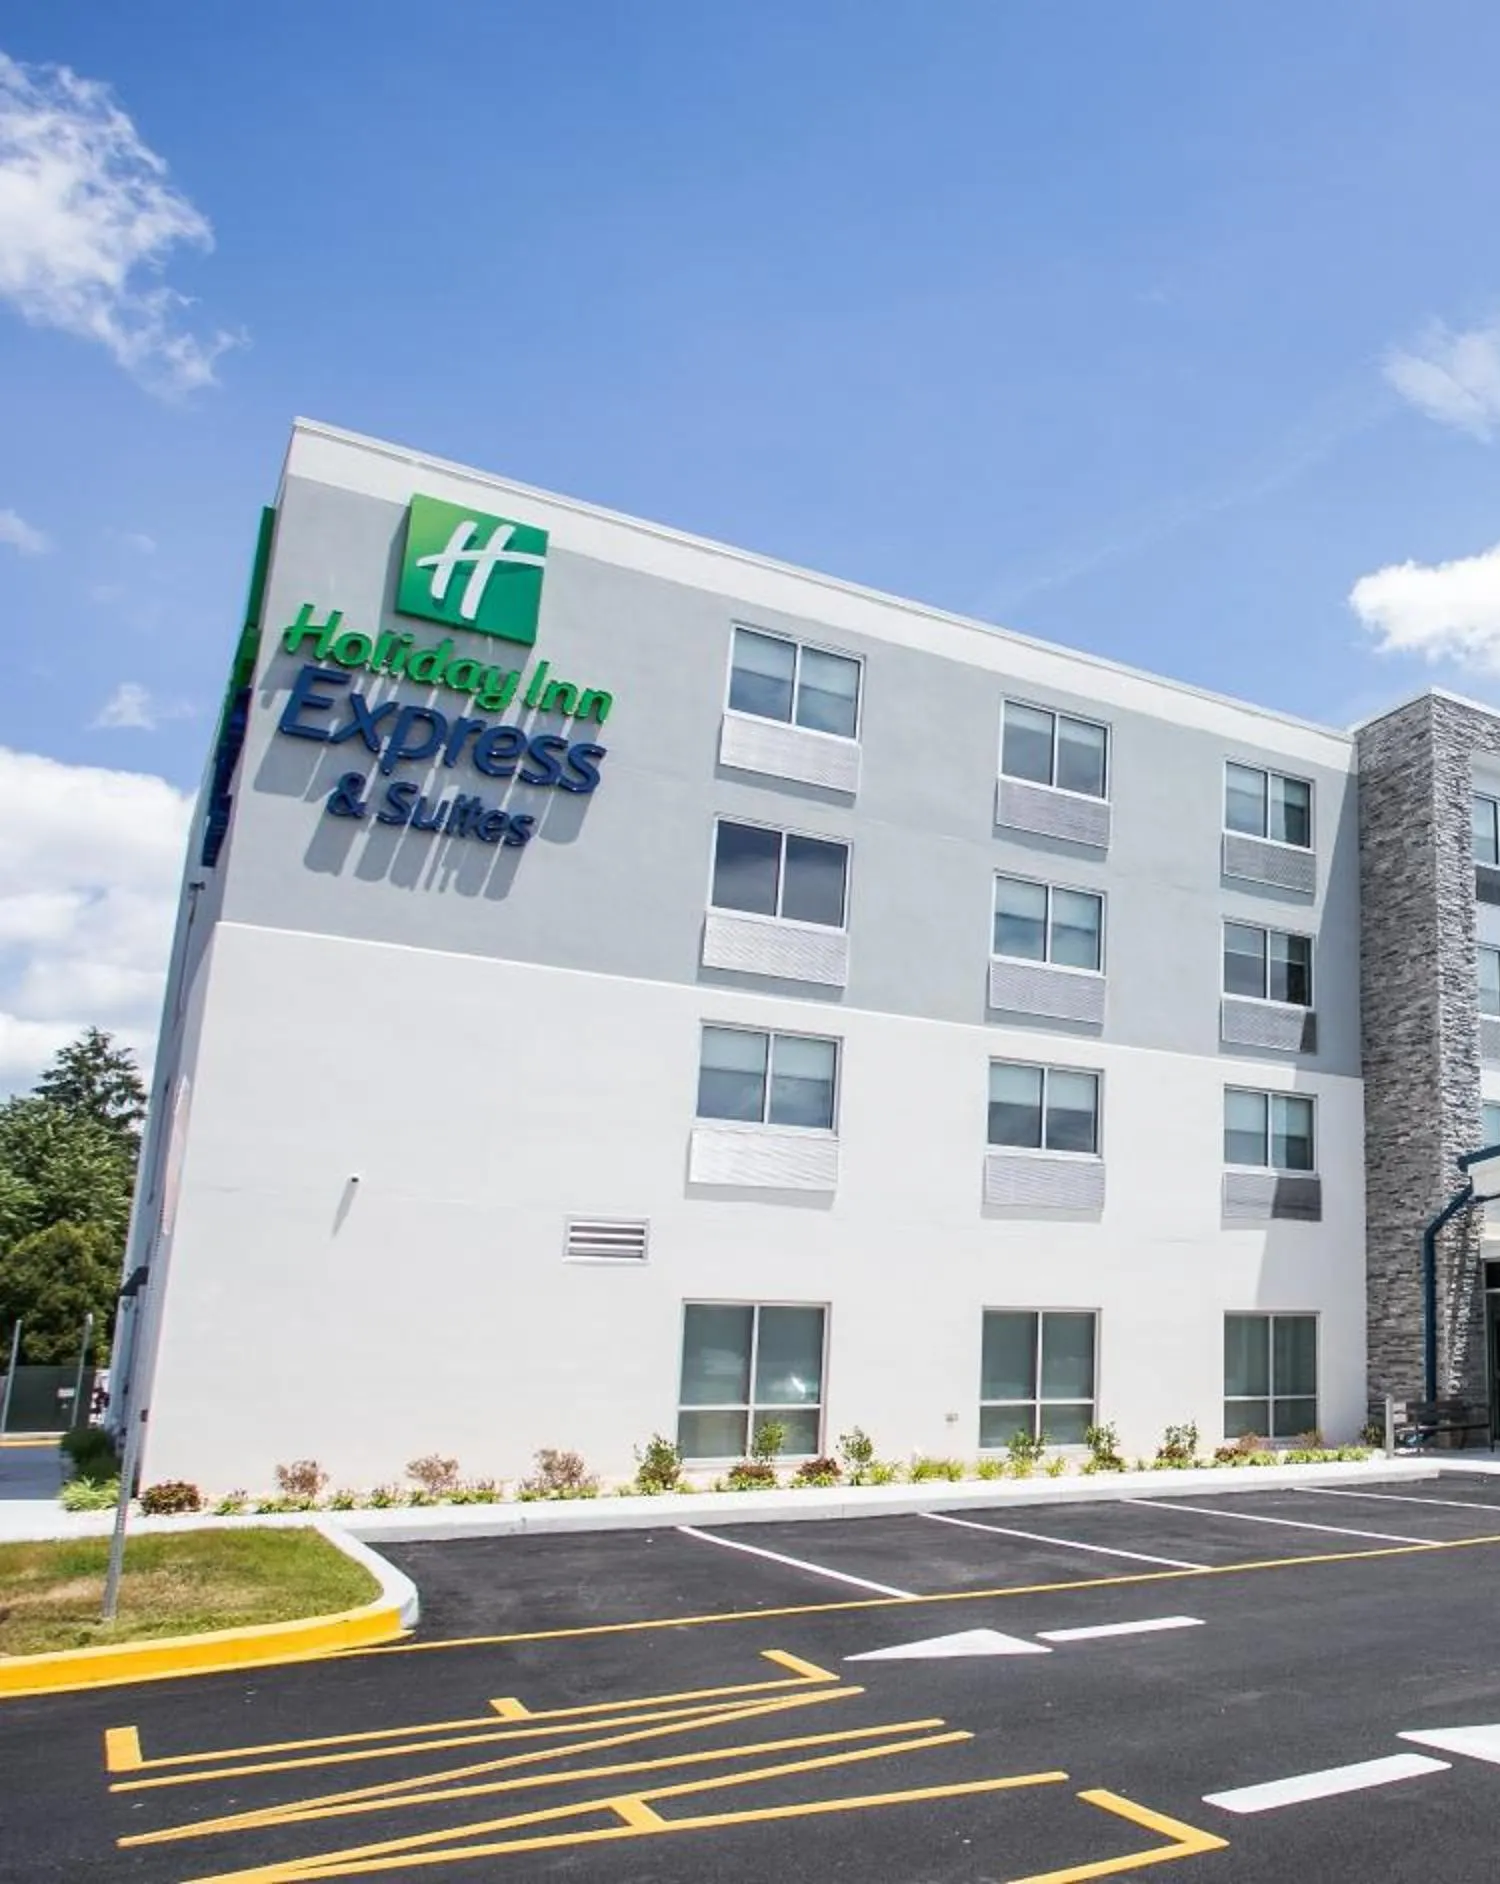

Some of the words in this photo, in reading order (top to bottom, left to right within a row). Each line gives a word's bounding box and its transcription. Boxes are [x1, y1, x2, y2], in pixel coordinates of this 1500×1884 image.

[283, 603, 519, 712] Holiday
[524, 661, 614, 724] Inn
[278, 664, 607, 794] Express
[327, 772, 367, 818] &
[377, 781, 535, 846] Suites
